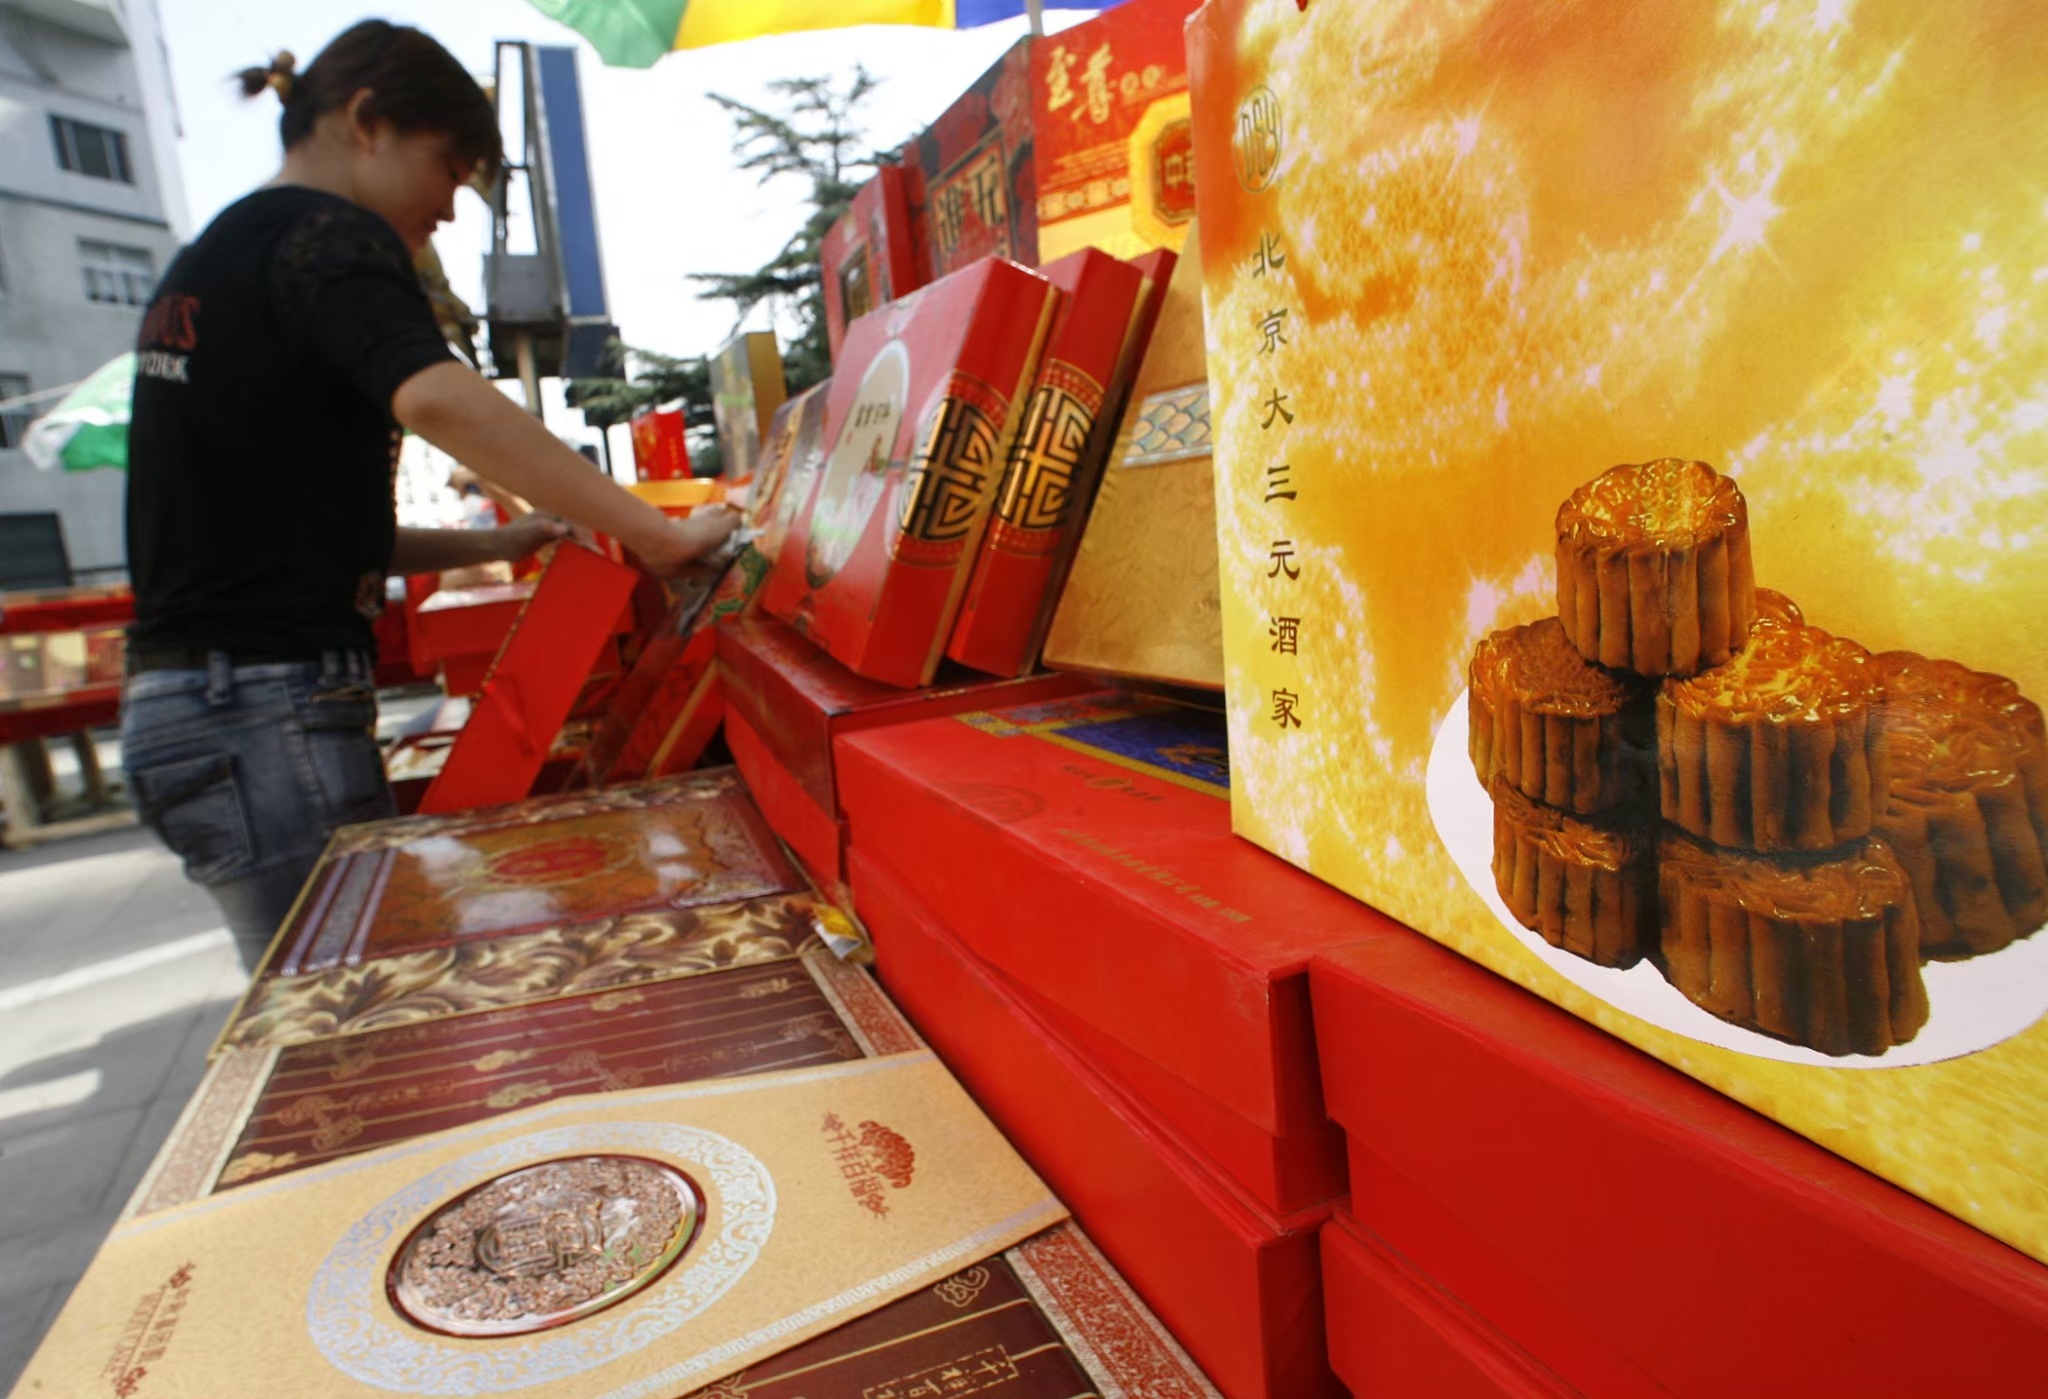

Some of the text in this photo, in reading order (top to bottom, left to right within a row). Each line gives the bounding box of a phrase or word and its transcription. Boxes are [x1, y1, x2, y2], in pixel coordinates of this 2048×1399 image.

[1253, 231, 1302, 729] 北京大三元酒家
